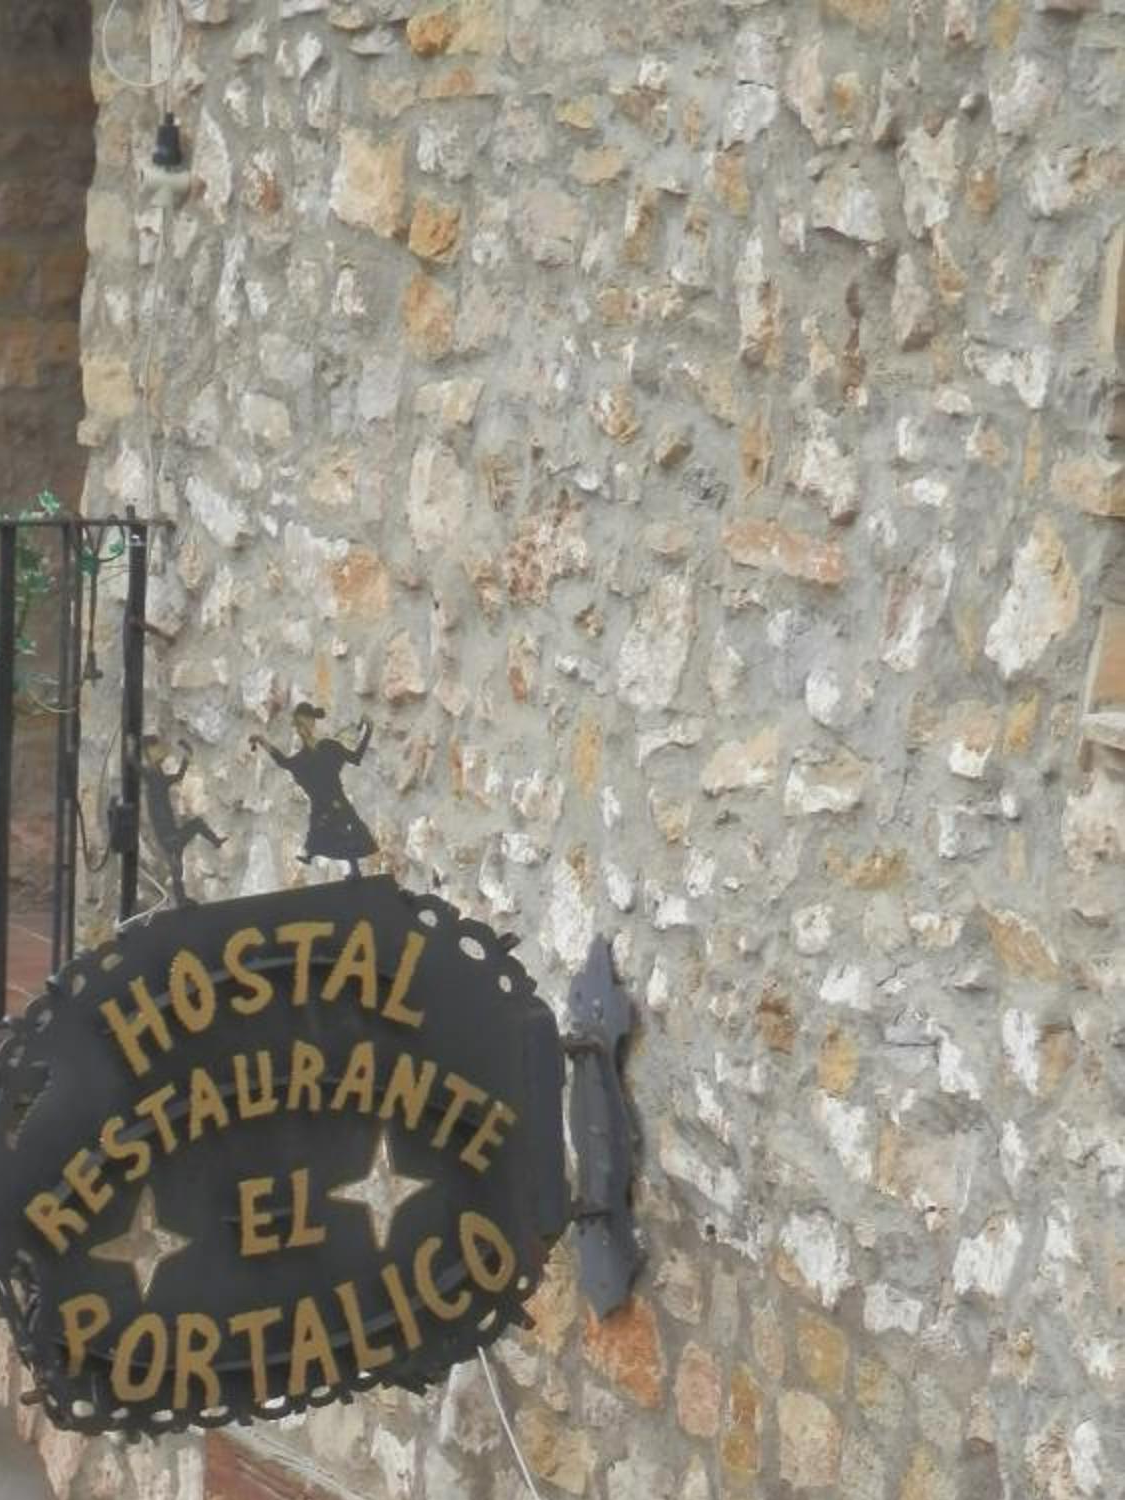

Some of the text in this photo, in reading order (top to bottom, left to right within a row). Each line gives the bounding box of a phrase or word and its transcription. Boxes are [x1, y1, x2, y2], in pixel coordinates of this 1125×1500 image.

[101, 920, 425, 1076] HOSTAL
[25, 1040, 517, 1255] RESTAURANTE
[239, 1168, 326, 1255] EL
[59, 1211, 517, 1408] PORTALICO
